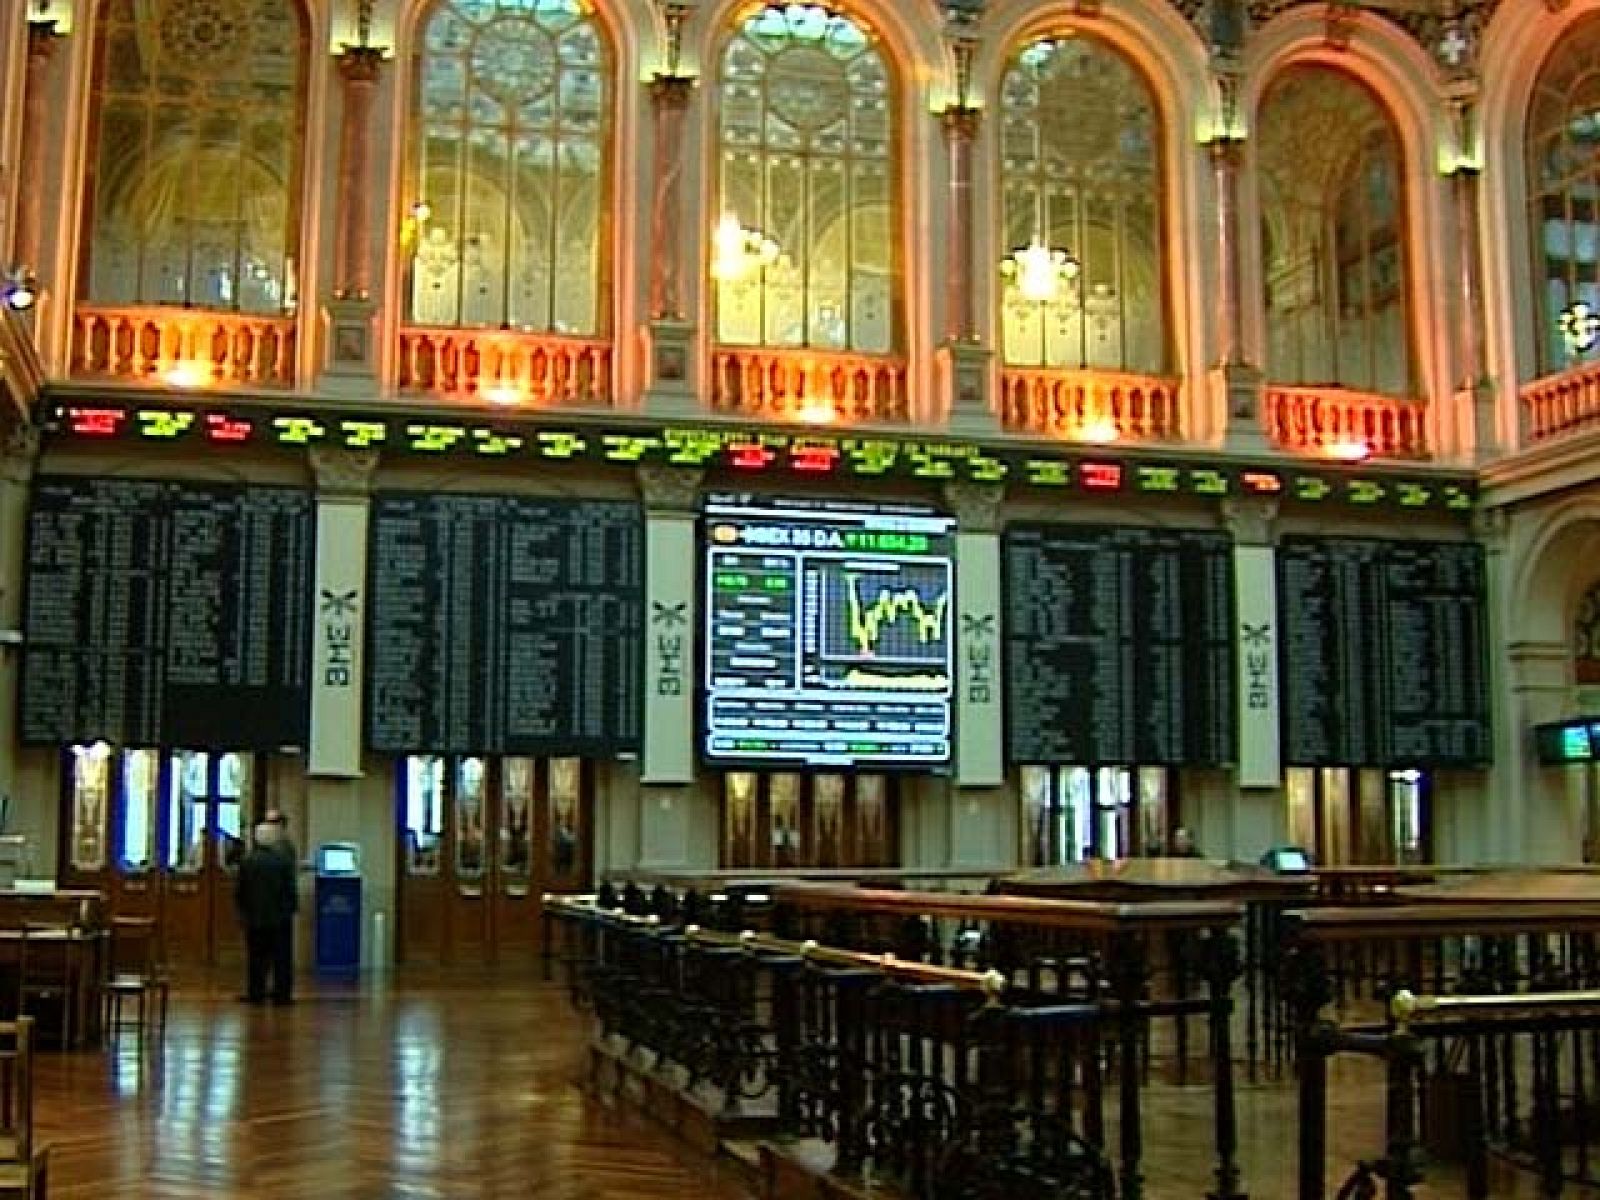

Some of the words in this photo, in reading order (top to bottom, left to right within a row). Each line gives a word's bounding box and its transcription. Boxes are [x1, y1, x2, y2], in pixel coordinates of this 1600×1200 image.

[325, 625, 350, 686] BME
[657, 635, 681, 696] BME
[969, 645, 990, 704] BME
[1248, 654, 1268, 709] BME
